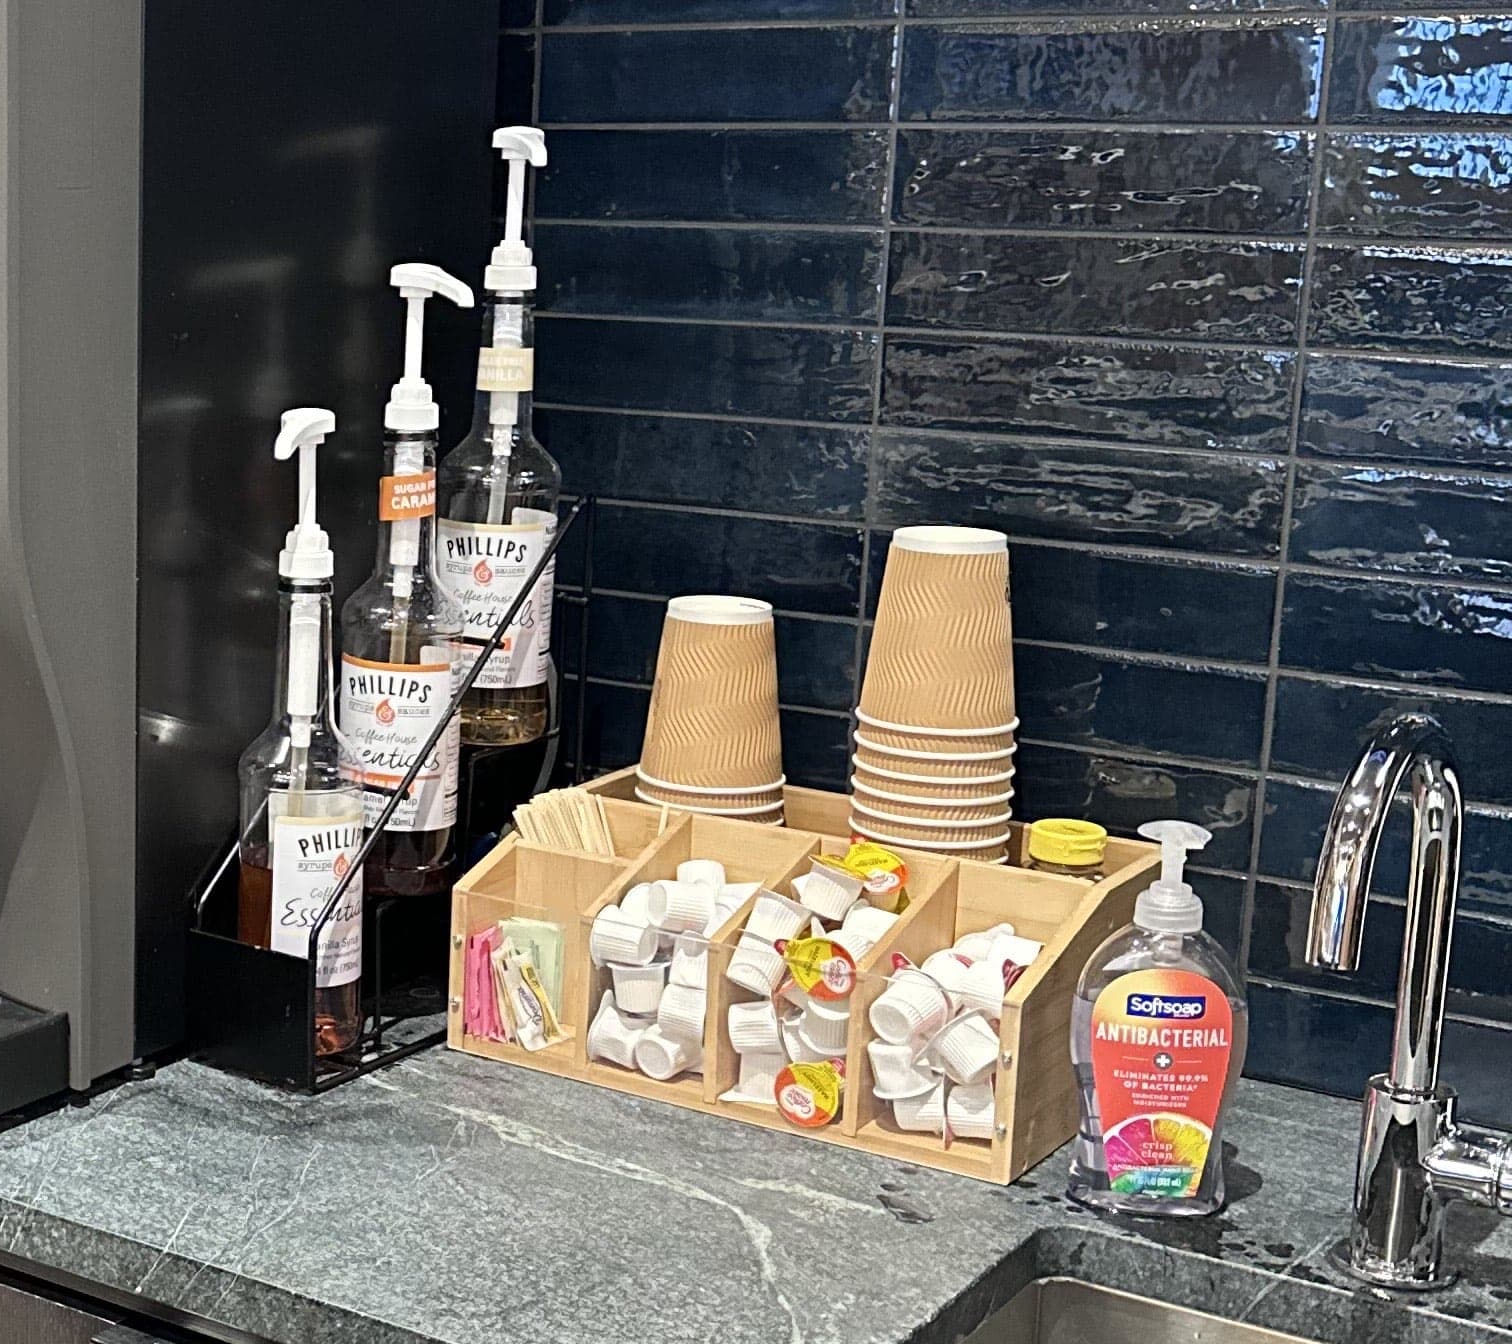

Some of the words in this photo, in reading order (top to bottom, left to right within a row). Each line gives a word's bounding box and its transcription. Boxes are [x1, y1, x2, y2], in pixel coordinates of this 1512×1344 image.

[393, 481, 427, 495] SUGAR
[447, 536, 528, 564] PHILLIPS
[485, 590, 513, 604] House
[489, 655, 511, 665] yrup
[349, 674, 432, 704] PHILLIPS
[355, 727, 386, 745] Coffee
[386, 731, 418, 746] House
[1130, 997, 1203, 1017] Softsoap
[1095, 1021, 1229, 1048] ANTIBACTERIAL
[1113, 1069, 1176, 1082] ELIMINATES
[1123, 1080, 1138, 1089] OF
[1142, 1141, 1173, 1153] crisp
[1141, 1150, 1173, 1160] clean
